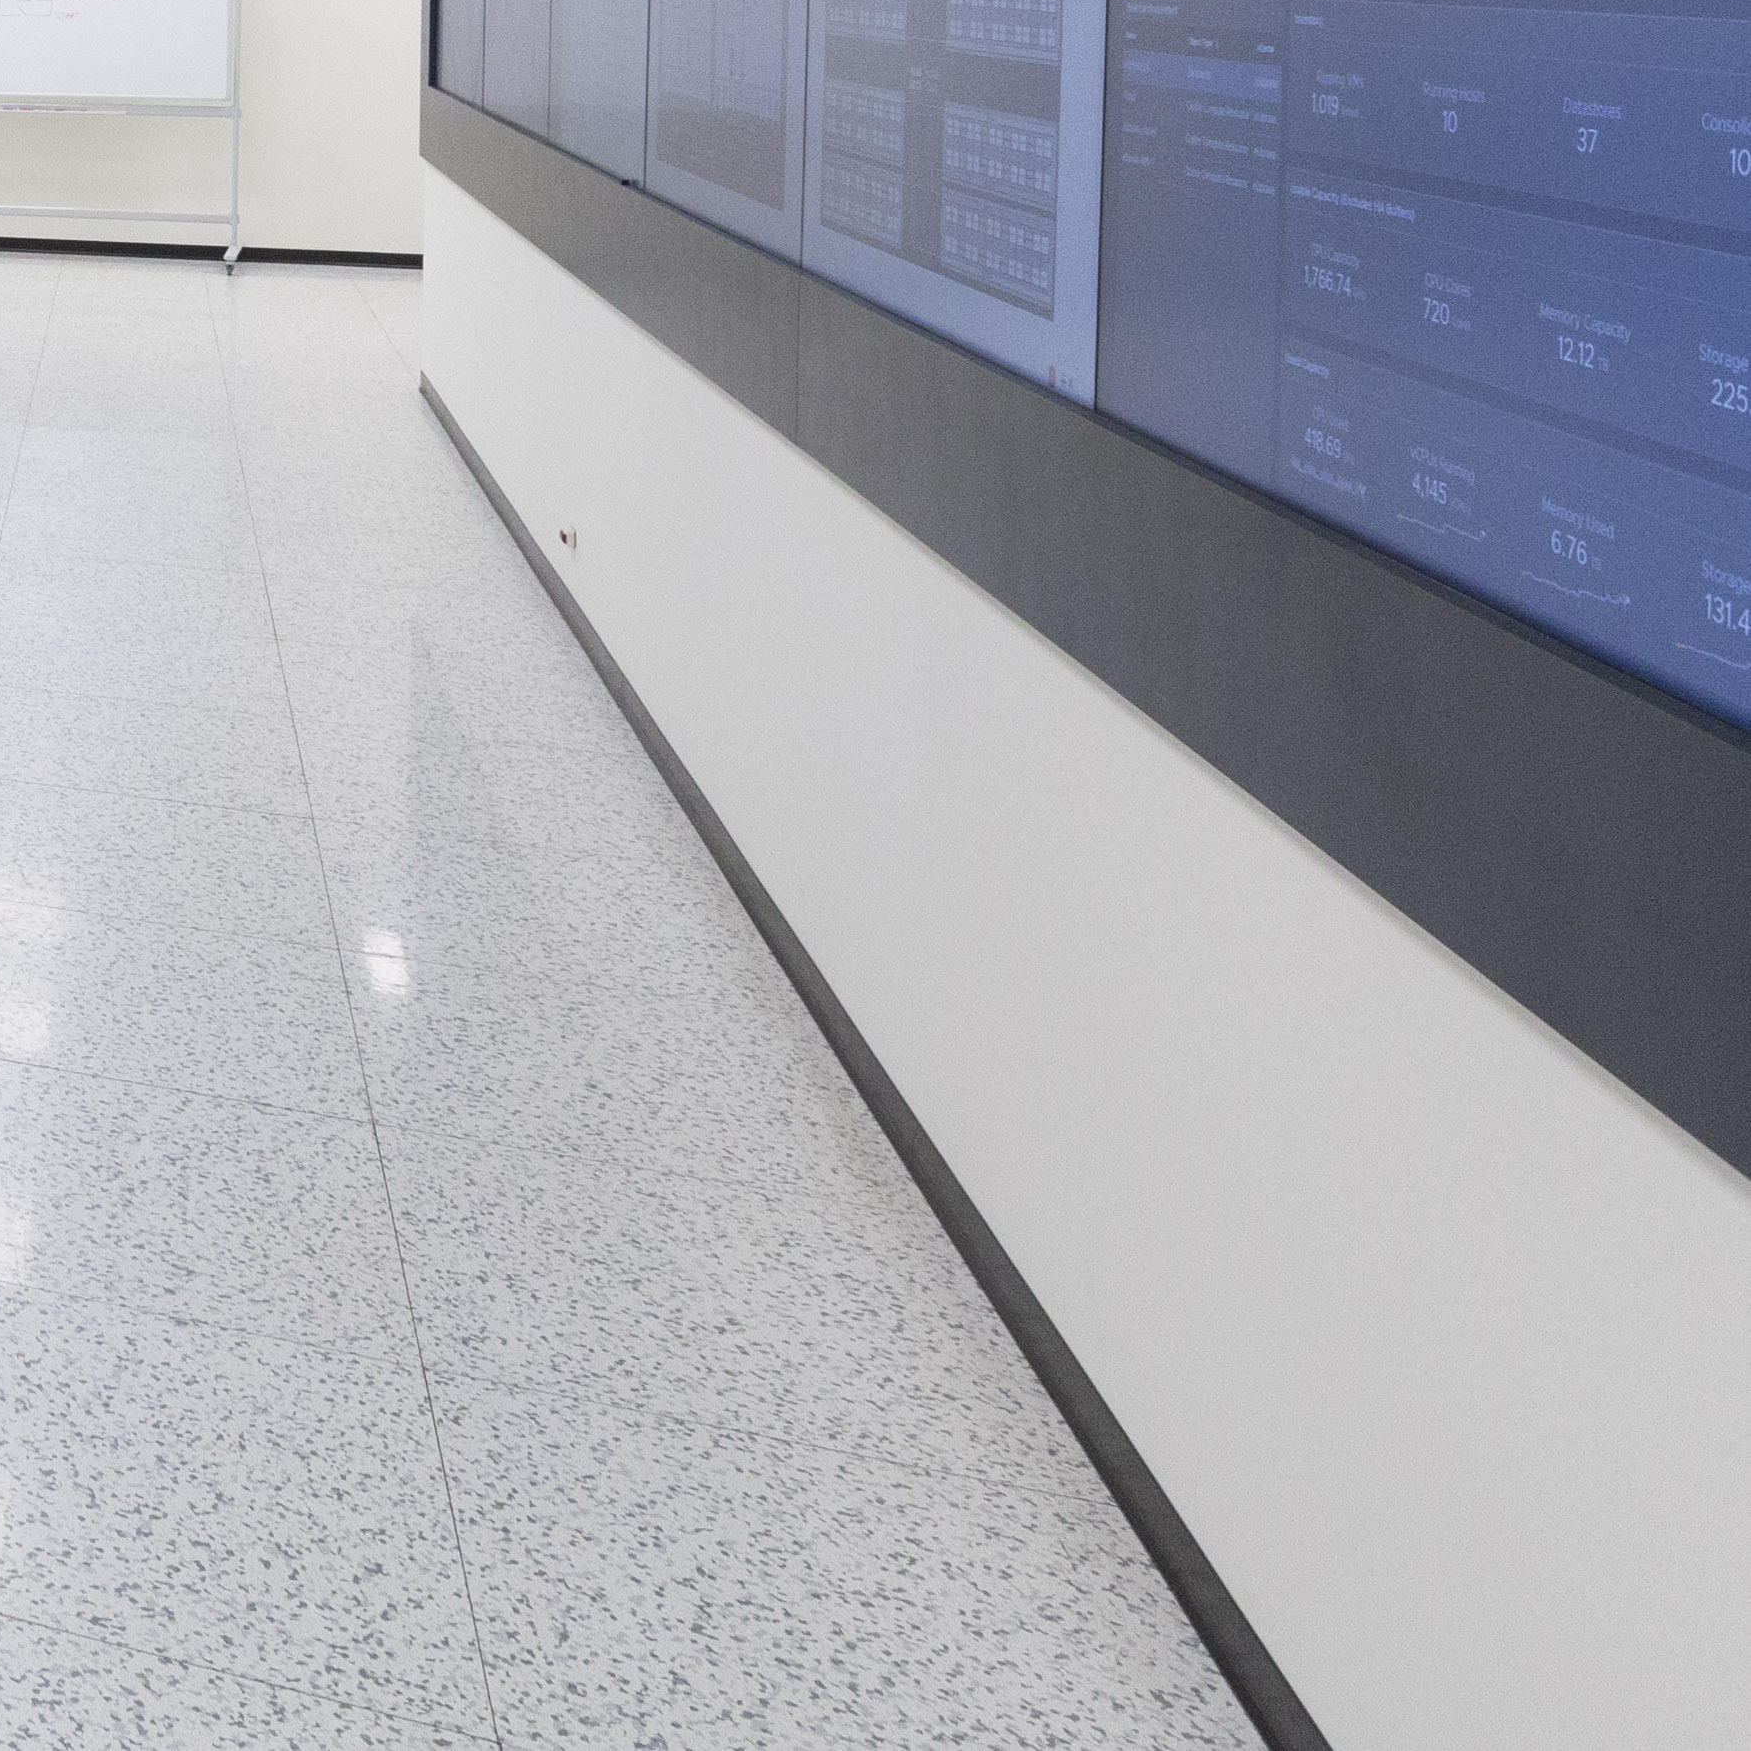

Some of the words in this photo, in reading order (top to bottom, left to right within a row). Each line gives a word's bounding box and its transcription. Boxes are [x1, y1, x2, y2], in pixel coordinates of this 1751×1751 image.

[1442, 109, 1459, 134] 10
[1562, 95, 1623, 122] Datastores
[1576, 126, 1598, 154] 37
[1423, 297, 1450, 326] 720
[1540, 302, 1583, 331] Memory
[1584, 313, 1632, 346] Capacity
[1558, 335, 1595, 370] 12.12
[1699, 342, 1749, 375] Storage
[1411, 471, 1448, 506] 4,145
[1542, 495, 1584, 530] Memory
[1586, 511, 1615, 540] Used
[1551, 529, 1588, 567] 6.76
